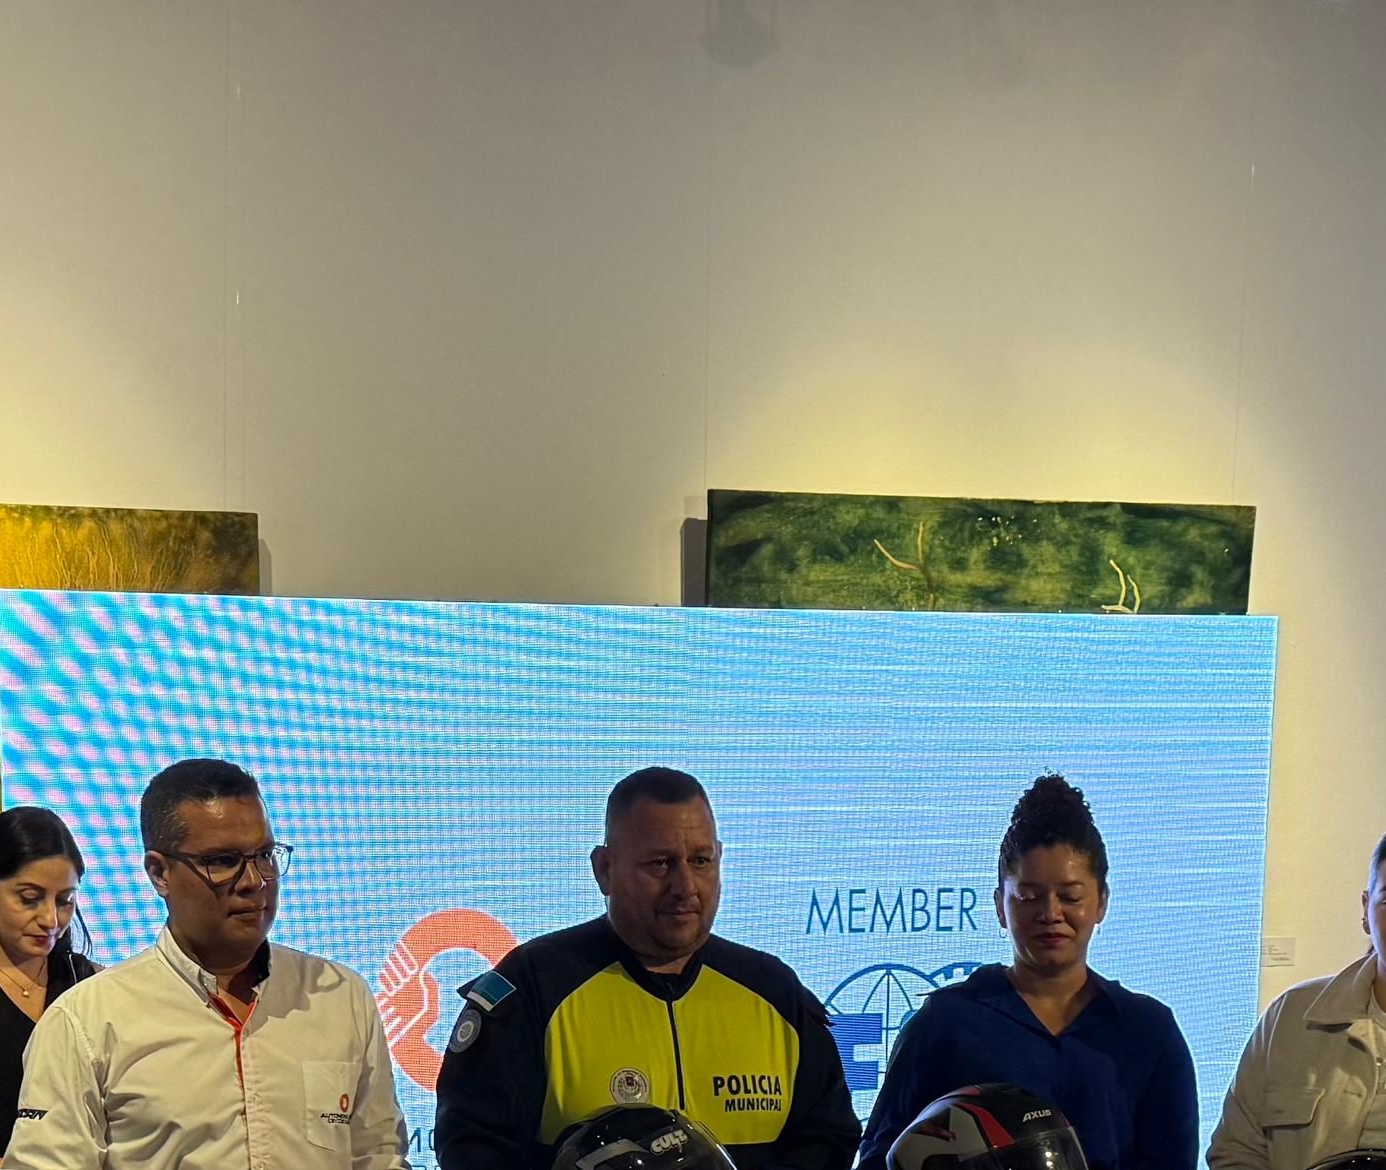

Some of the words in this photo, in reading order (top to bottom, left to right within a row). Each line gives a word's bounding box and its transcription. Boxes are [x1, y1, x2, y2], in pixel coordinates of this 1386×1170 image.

[806, 886, 978, 935] MEMBER
[713, 1074, 782, 1097] POLICIA
[1022, 1108, 1054, 1123] AXUS
